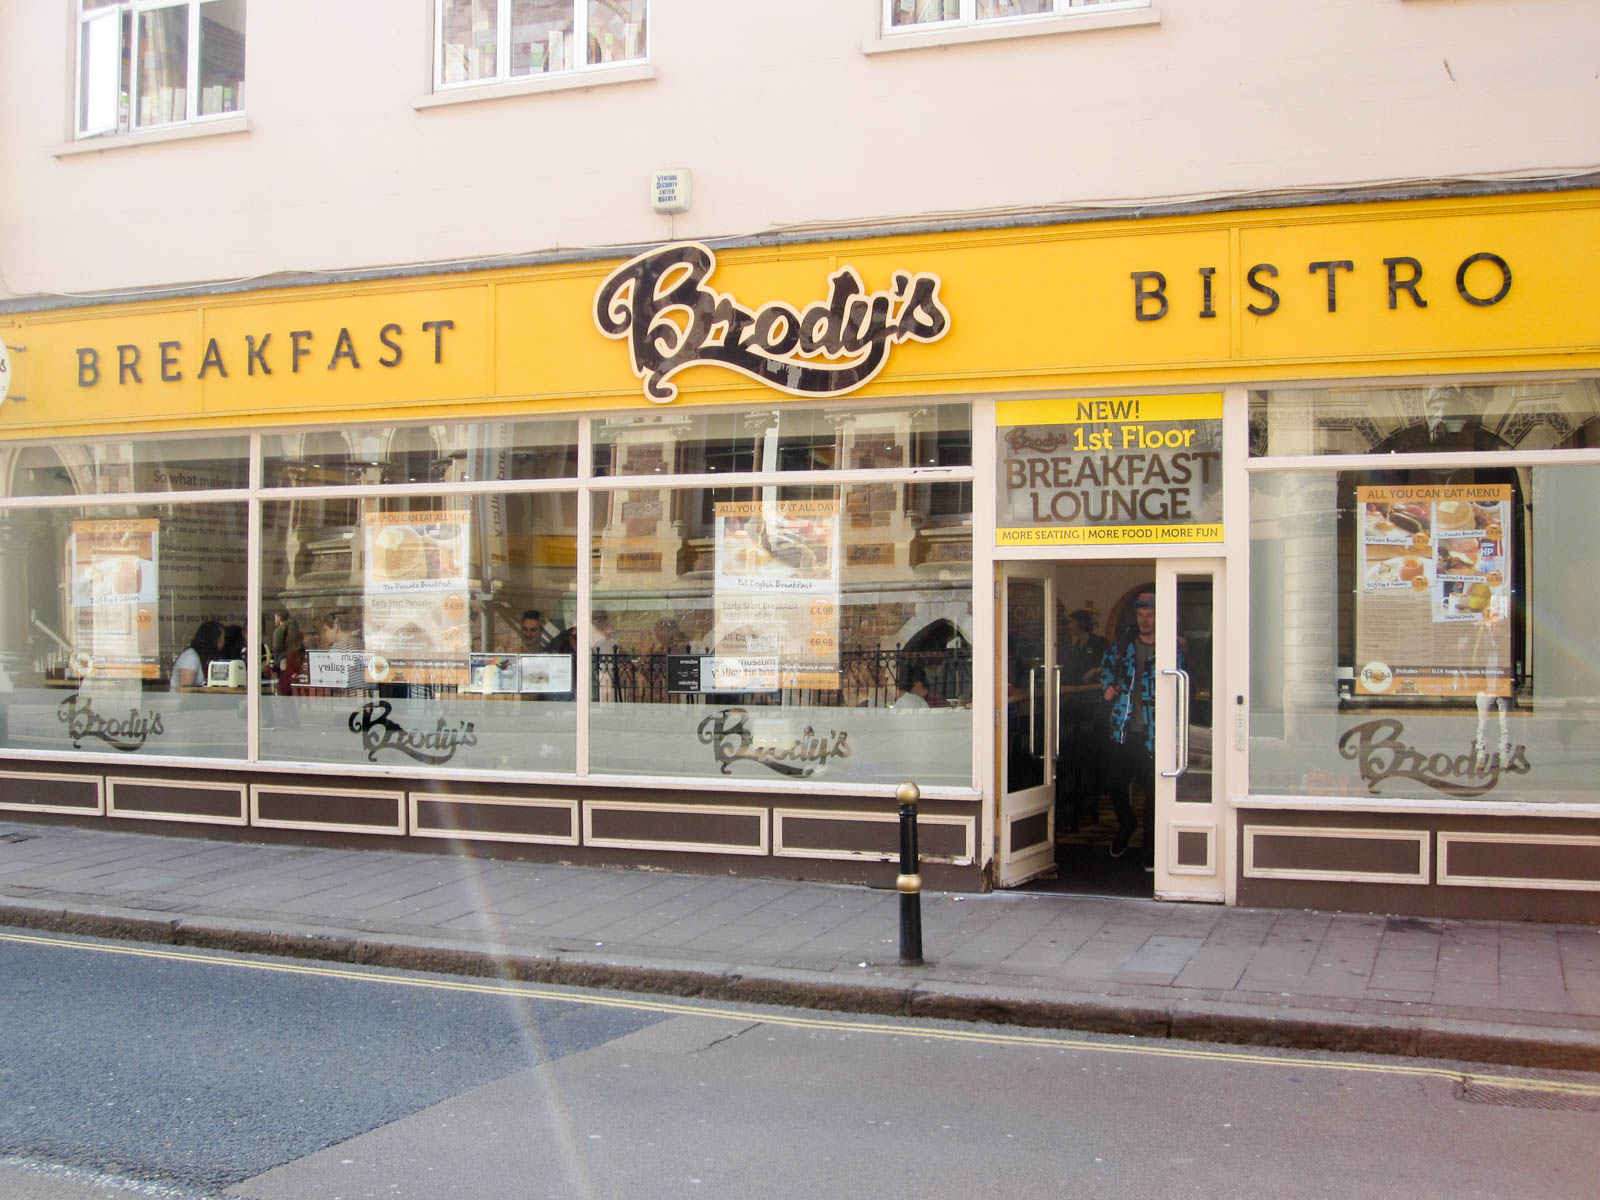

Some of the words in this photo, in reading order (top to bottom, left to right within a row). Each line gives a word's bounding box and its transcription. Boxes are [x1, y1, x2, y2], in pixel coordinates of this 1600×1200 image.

[1130, 252, 1512, 322] BISTRO
[595, 243, 949, 402] Brody's
[75, 319, 454, 387] BREAKFAST
[1076, 400, 1140, 421] NEW!
[1004, 427, 1069, 454] Brody's
[1073, 427, 1113, 451] 1st
[1121, 425, 1196, 449] Floor
[153, 470, 167, 483] So
[169, 473, 197, 486] what
[1004, 452, 1220, 489] BREAKFAST
[1030, 488, 1192, 522] LOUNGE
[1367, 490, 1388, 499] ALL
[1390, 489, 1414, 499] YOU
[1415, 488, 1440, 498] CAN
[1443, 488, 1463, 498] EAT
[1466, 487, 1501, 498] MENU
[383, 514, 400, 522] YOU
[401, 513, 418, 522] CAN
[419, 513, 434, 521] EAT
[719, 505, 736, 513] ALL
[737, 504, 756, 512] YOU
[799, 503, 816, 511] ALL
[817, 503, 835, 511] DAY
[1002, 530, 1033, 540] MORE
[1035, 529, 1080, 540] SEATING
[1087, 529, 1120, 539] MORE
[1121, 528, 1153, 538] FOOD
[1160, 528, 1194, 538] MORE
[1195, 527, 1219, 537] FUN
[775, 580, 813, 589] Breakfast
[809, 607, 834, 616] £4.99
[57, 693, 165, 752] Brody's
[348, 700, 478, 765] Brody's
[1338, 718, 1530, 797] Brody's
